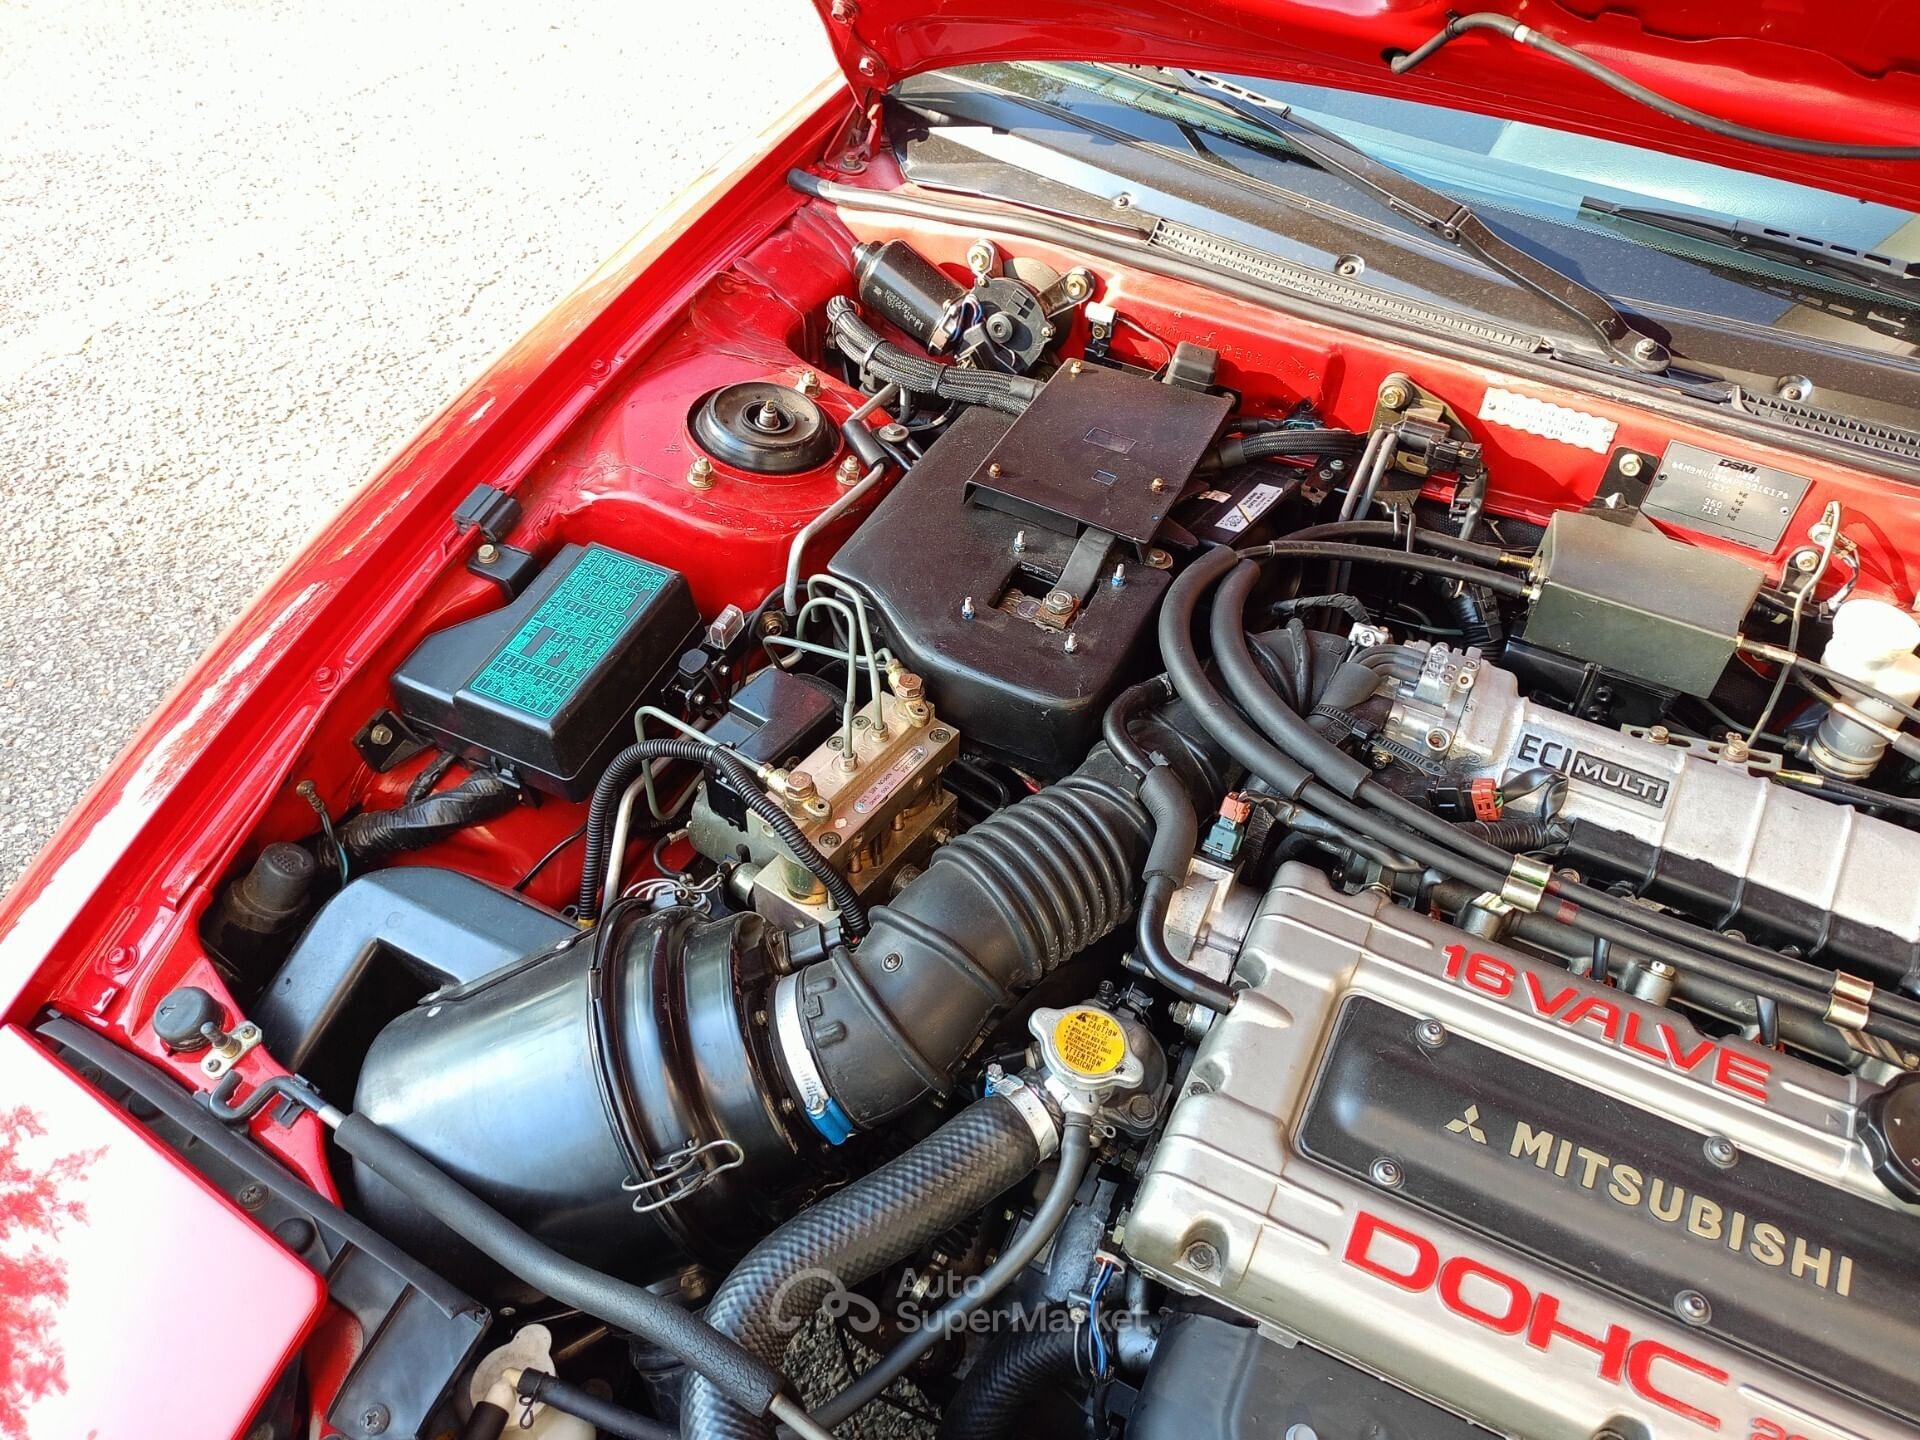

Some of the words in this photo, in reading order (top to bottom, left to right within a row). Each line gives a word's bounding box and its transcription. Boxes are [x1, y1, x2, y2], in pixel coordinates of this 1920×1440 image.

[1718, 457, 1757, 475] DSM
[1517, 733, 1573, 776] ECI
[1574, 757, 1666, 802] MULTI
[1087, 1020, 1118, 1039] CAUTION
[1063, 1045, 1102, 1067] ATTENTION
[1508, 1121, 1853, 1297] MITSUBISHI
[1342, 1210, 1730, 1431] DOHC
